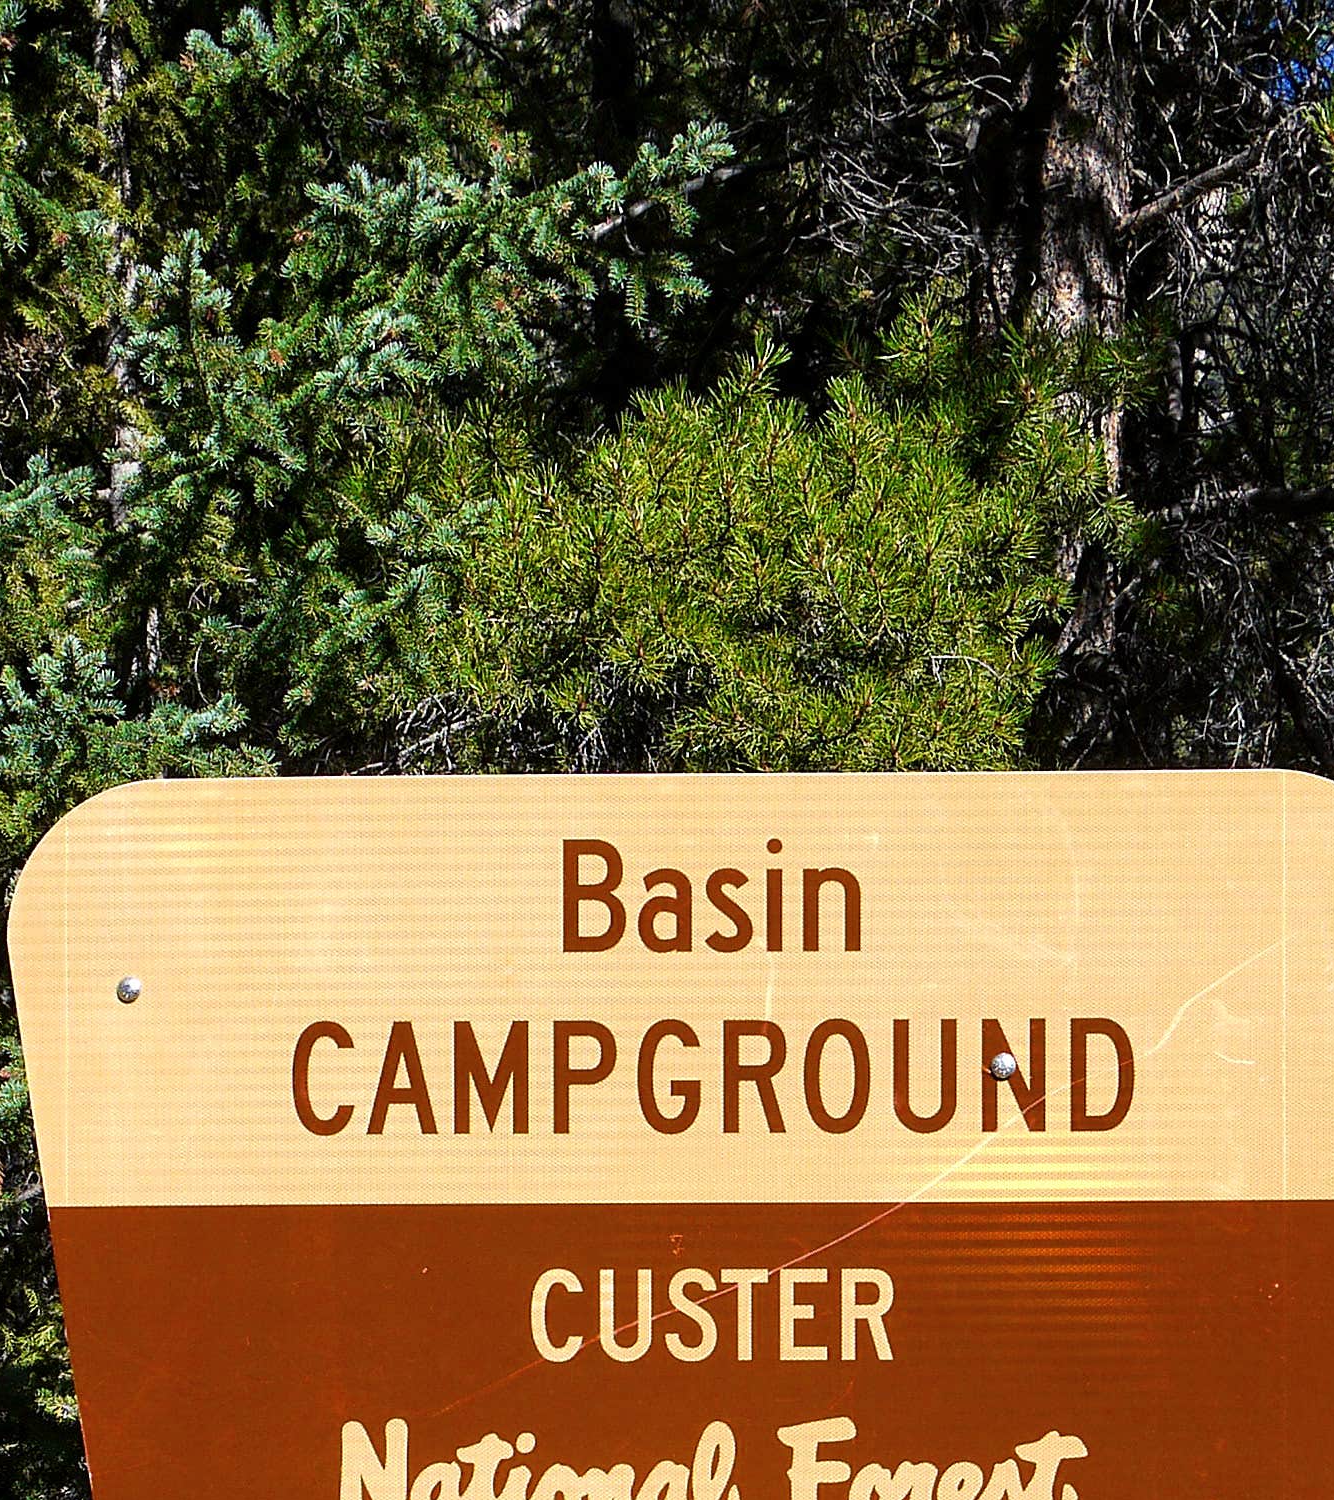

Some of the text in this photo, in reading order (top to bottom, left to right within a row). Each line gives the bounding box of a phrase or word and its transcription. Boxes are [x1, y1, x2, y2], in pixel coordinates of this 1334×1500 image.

[563, 839, 860, 953] Basin
[293, 1018, 1135, 1136] CAMPGROUND
[531, 1268, 893, 1362] CUSTER
